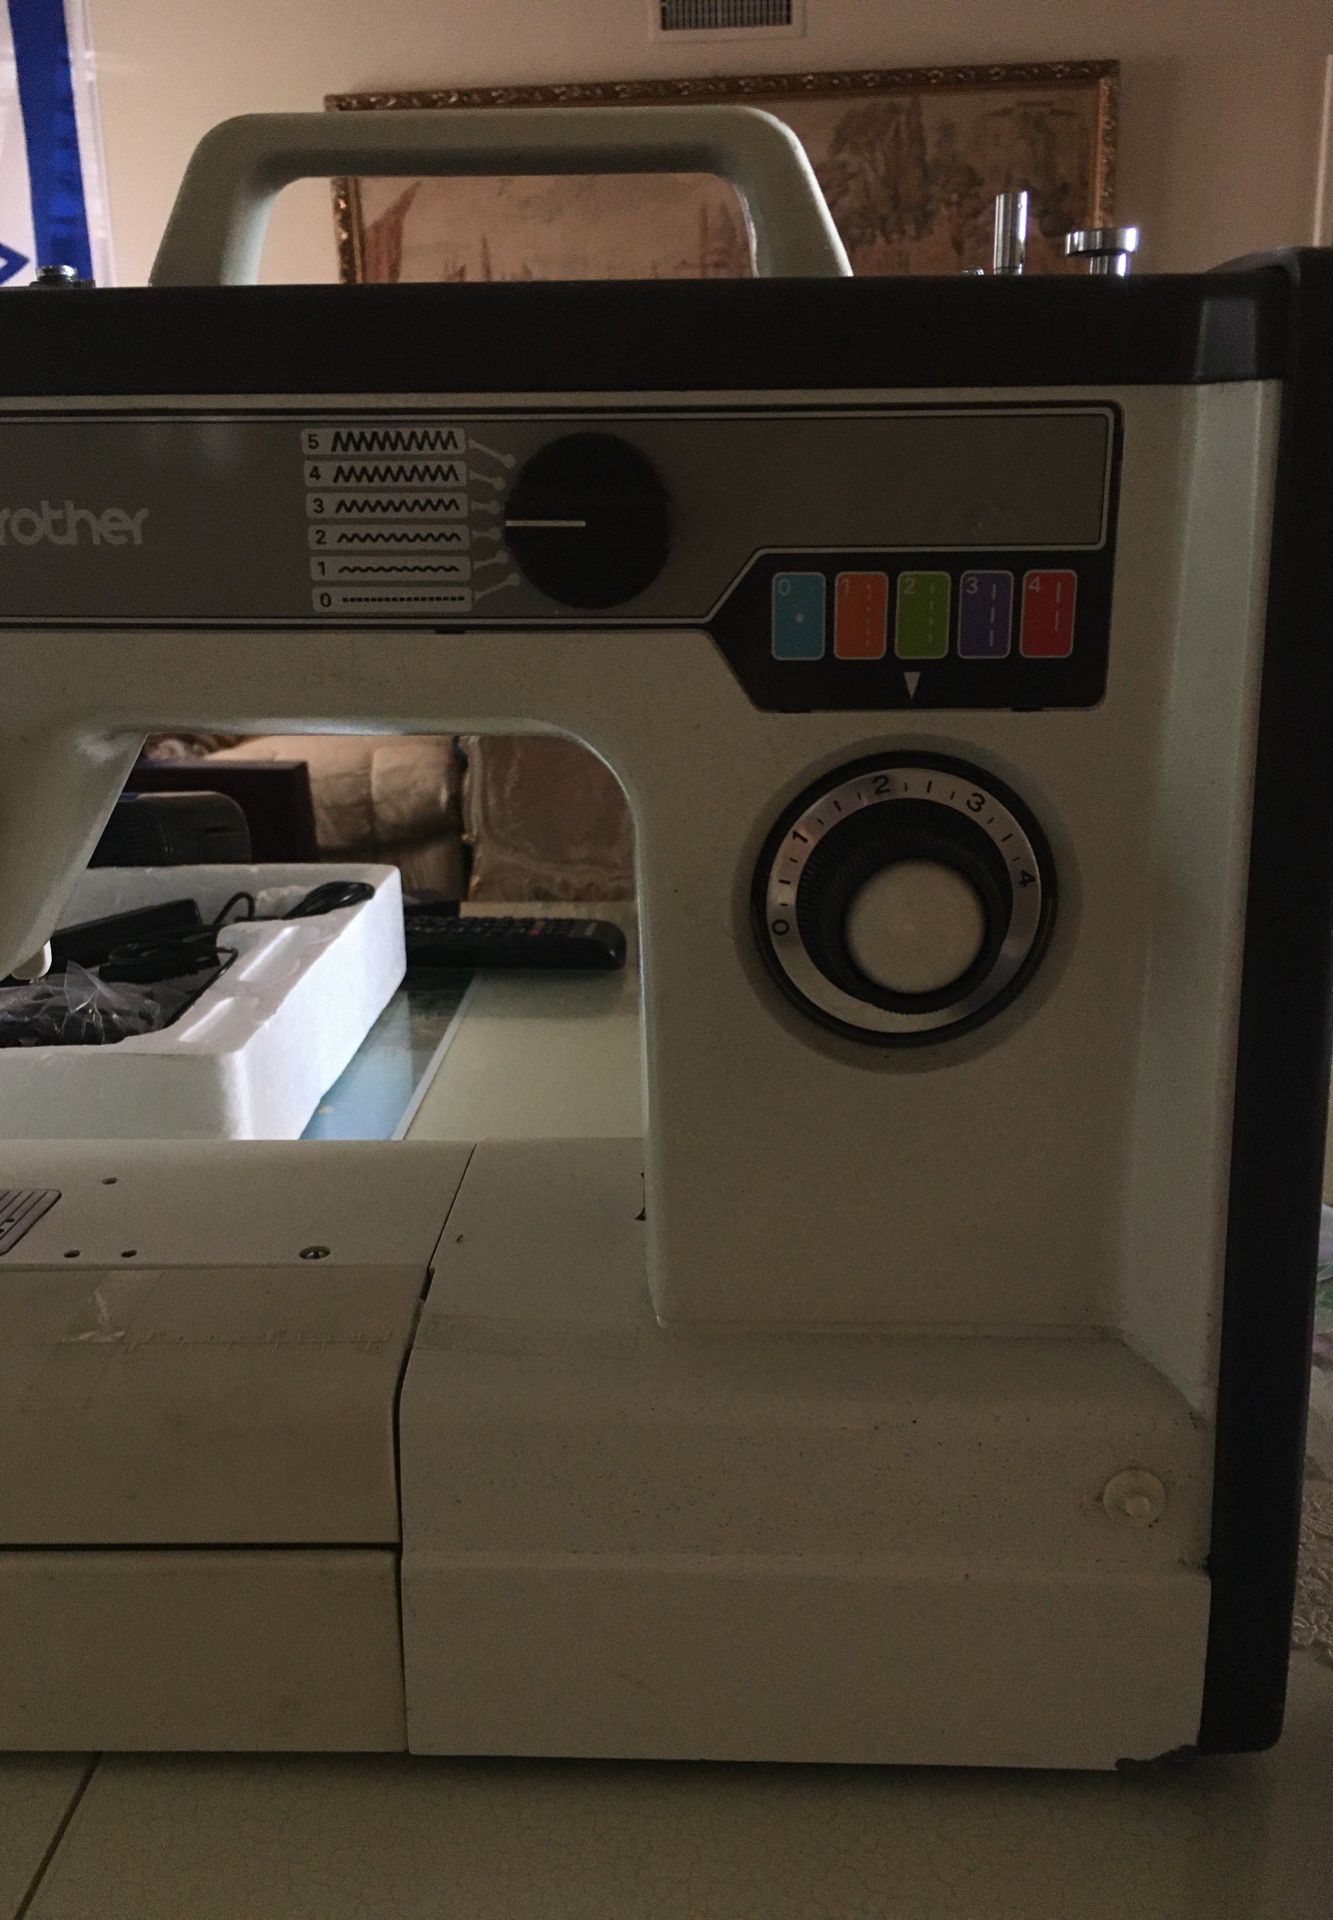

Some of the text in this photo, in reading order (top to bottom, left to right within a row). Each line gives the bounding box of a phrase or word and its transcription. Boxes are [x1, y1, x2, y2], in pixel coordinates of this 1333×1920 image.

[308, 434, 320, 450] 5
[309, 466, 321, 481] 4
[313, 498, 325, 514] 3
[316, 529, 327, 545] 2
[317, 561, 326, 576] 1
[777, 576, 1042, 596] 0 1 2 3 4
[320, 593, 332, 608] 0
[771, 775, 1037, 936] 0 1 2 3 4
